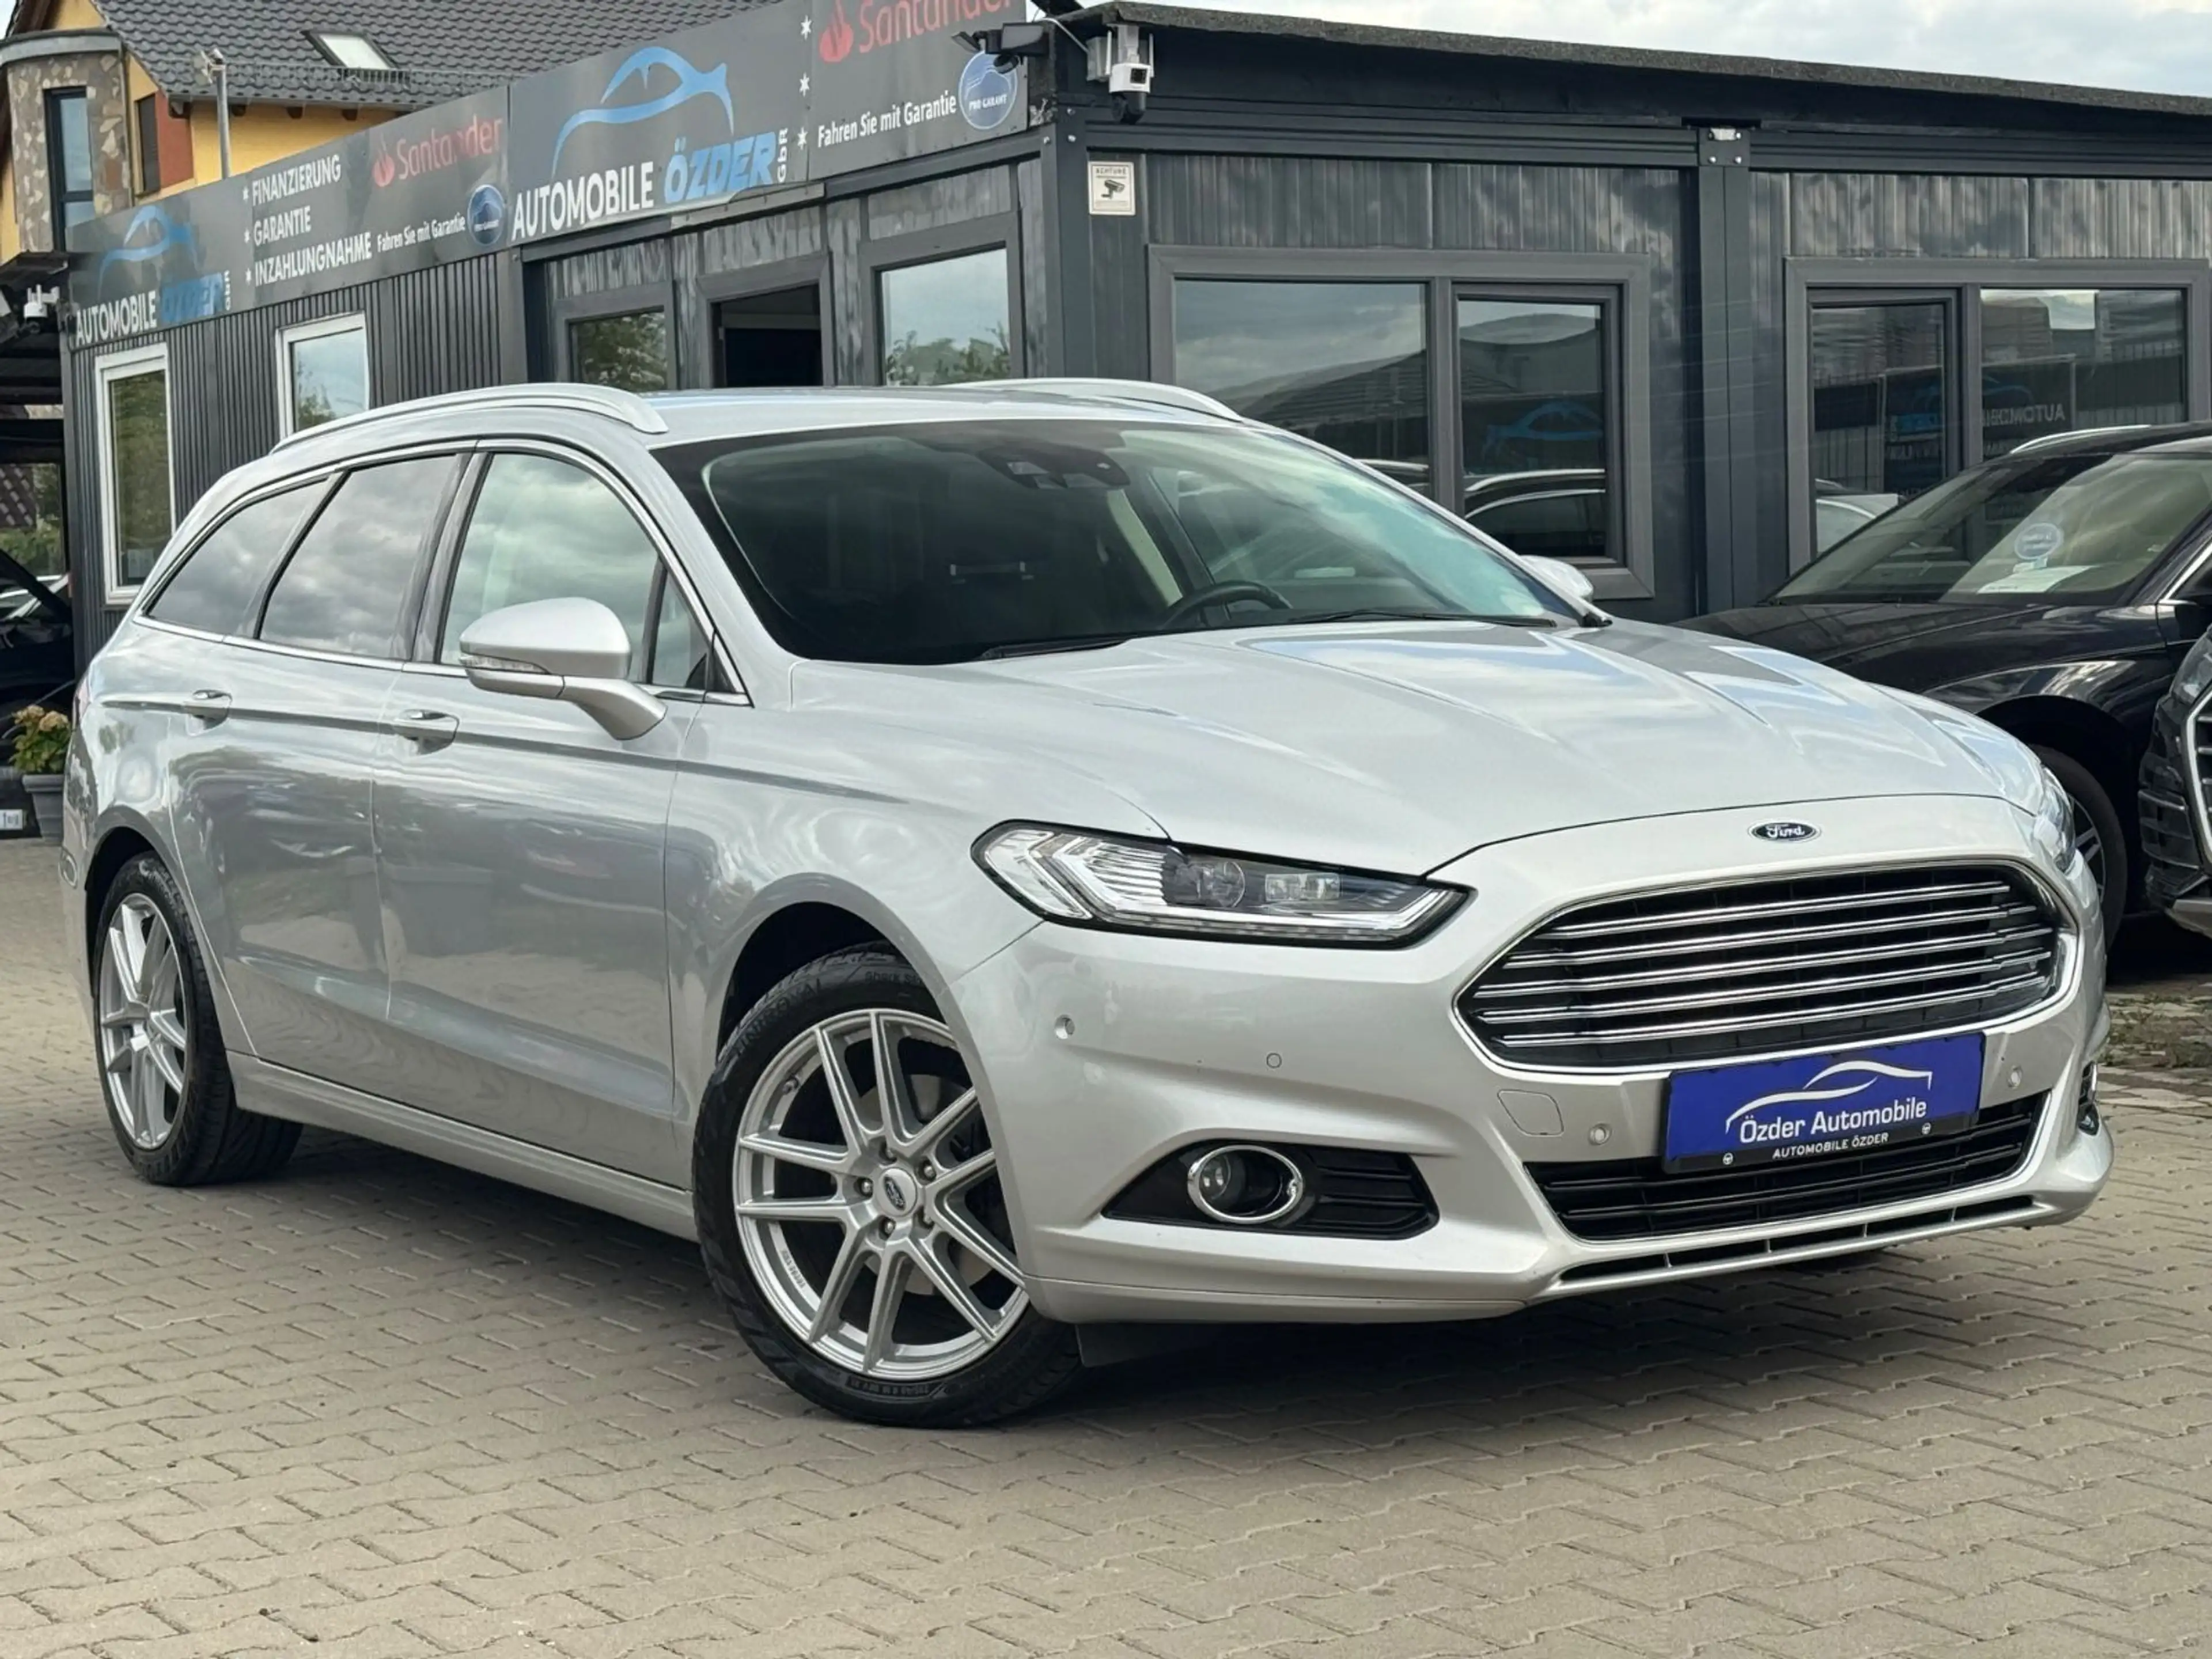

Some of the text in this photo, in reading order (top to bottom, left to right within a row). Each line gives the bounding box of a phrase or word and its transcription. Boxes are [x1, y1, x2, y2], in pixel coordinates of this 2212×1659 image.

[859, 0, 1012, 53] Santan
[817, 90, 957, 148] Fahren Sie mit Garantie
[252, 154, 341, 206] FINANZIERUNG
[777, 127, 788, 183] GbR
[510, 131, 776, 242] AUTOMOBILE ÖZDER
[253, 205, 312, 247] GARANTIE
[377, 231, 403, 252] Fahren
[404, 225, 416, 246] Sie
[417, 221, 431, 243] mit
[431, 211, 465, 239] Garantie
[255, 231, 372, 287] INZAHLUNGNAHME
[75, 290, 157, 347] AUTOMOBILE
[1739, 1096, 1927, 1144] Özder Automobile
[1771, 1131, 1889, 1160] AUTOMOBILE ÖZDER
